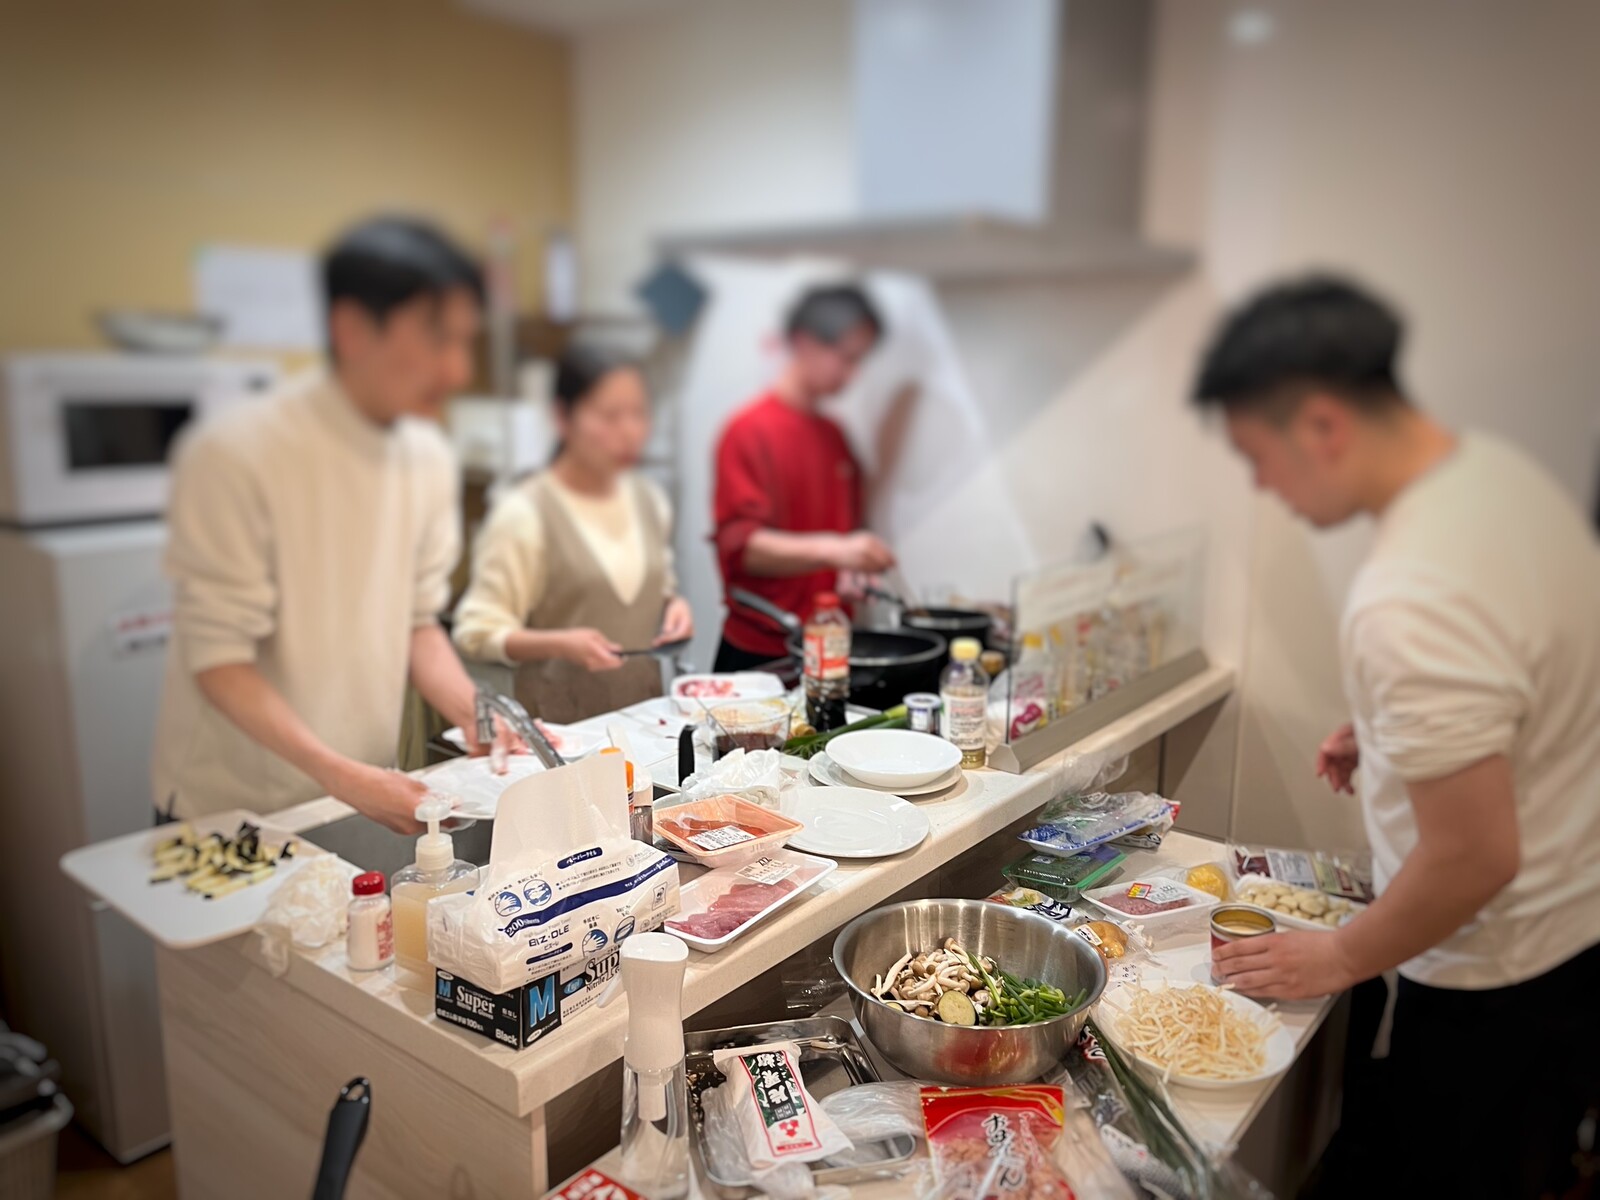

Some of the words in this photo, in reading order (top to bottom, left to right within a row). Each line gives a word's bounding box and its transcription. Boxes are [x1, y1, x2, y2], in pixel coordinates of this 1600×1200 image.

[506, 919, 524, 936] 200
[585, 951, 620, 984] Sup
[438, 979, 451, 998] M
[456, 985, 496, 1014] Super
[529, 975, 555, 1028] M
[495, 1028, 517, 1046] Black
